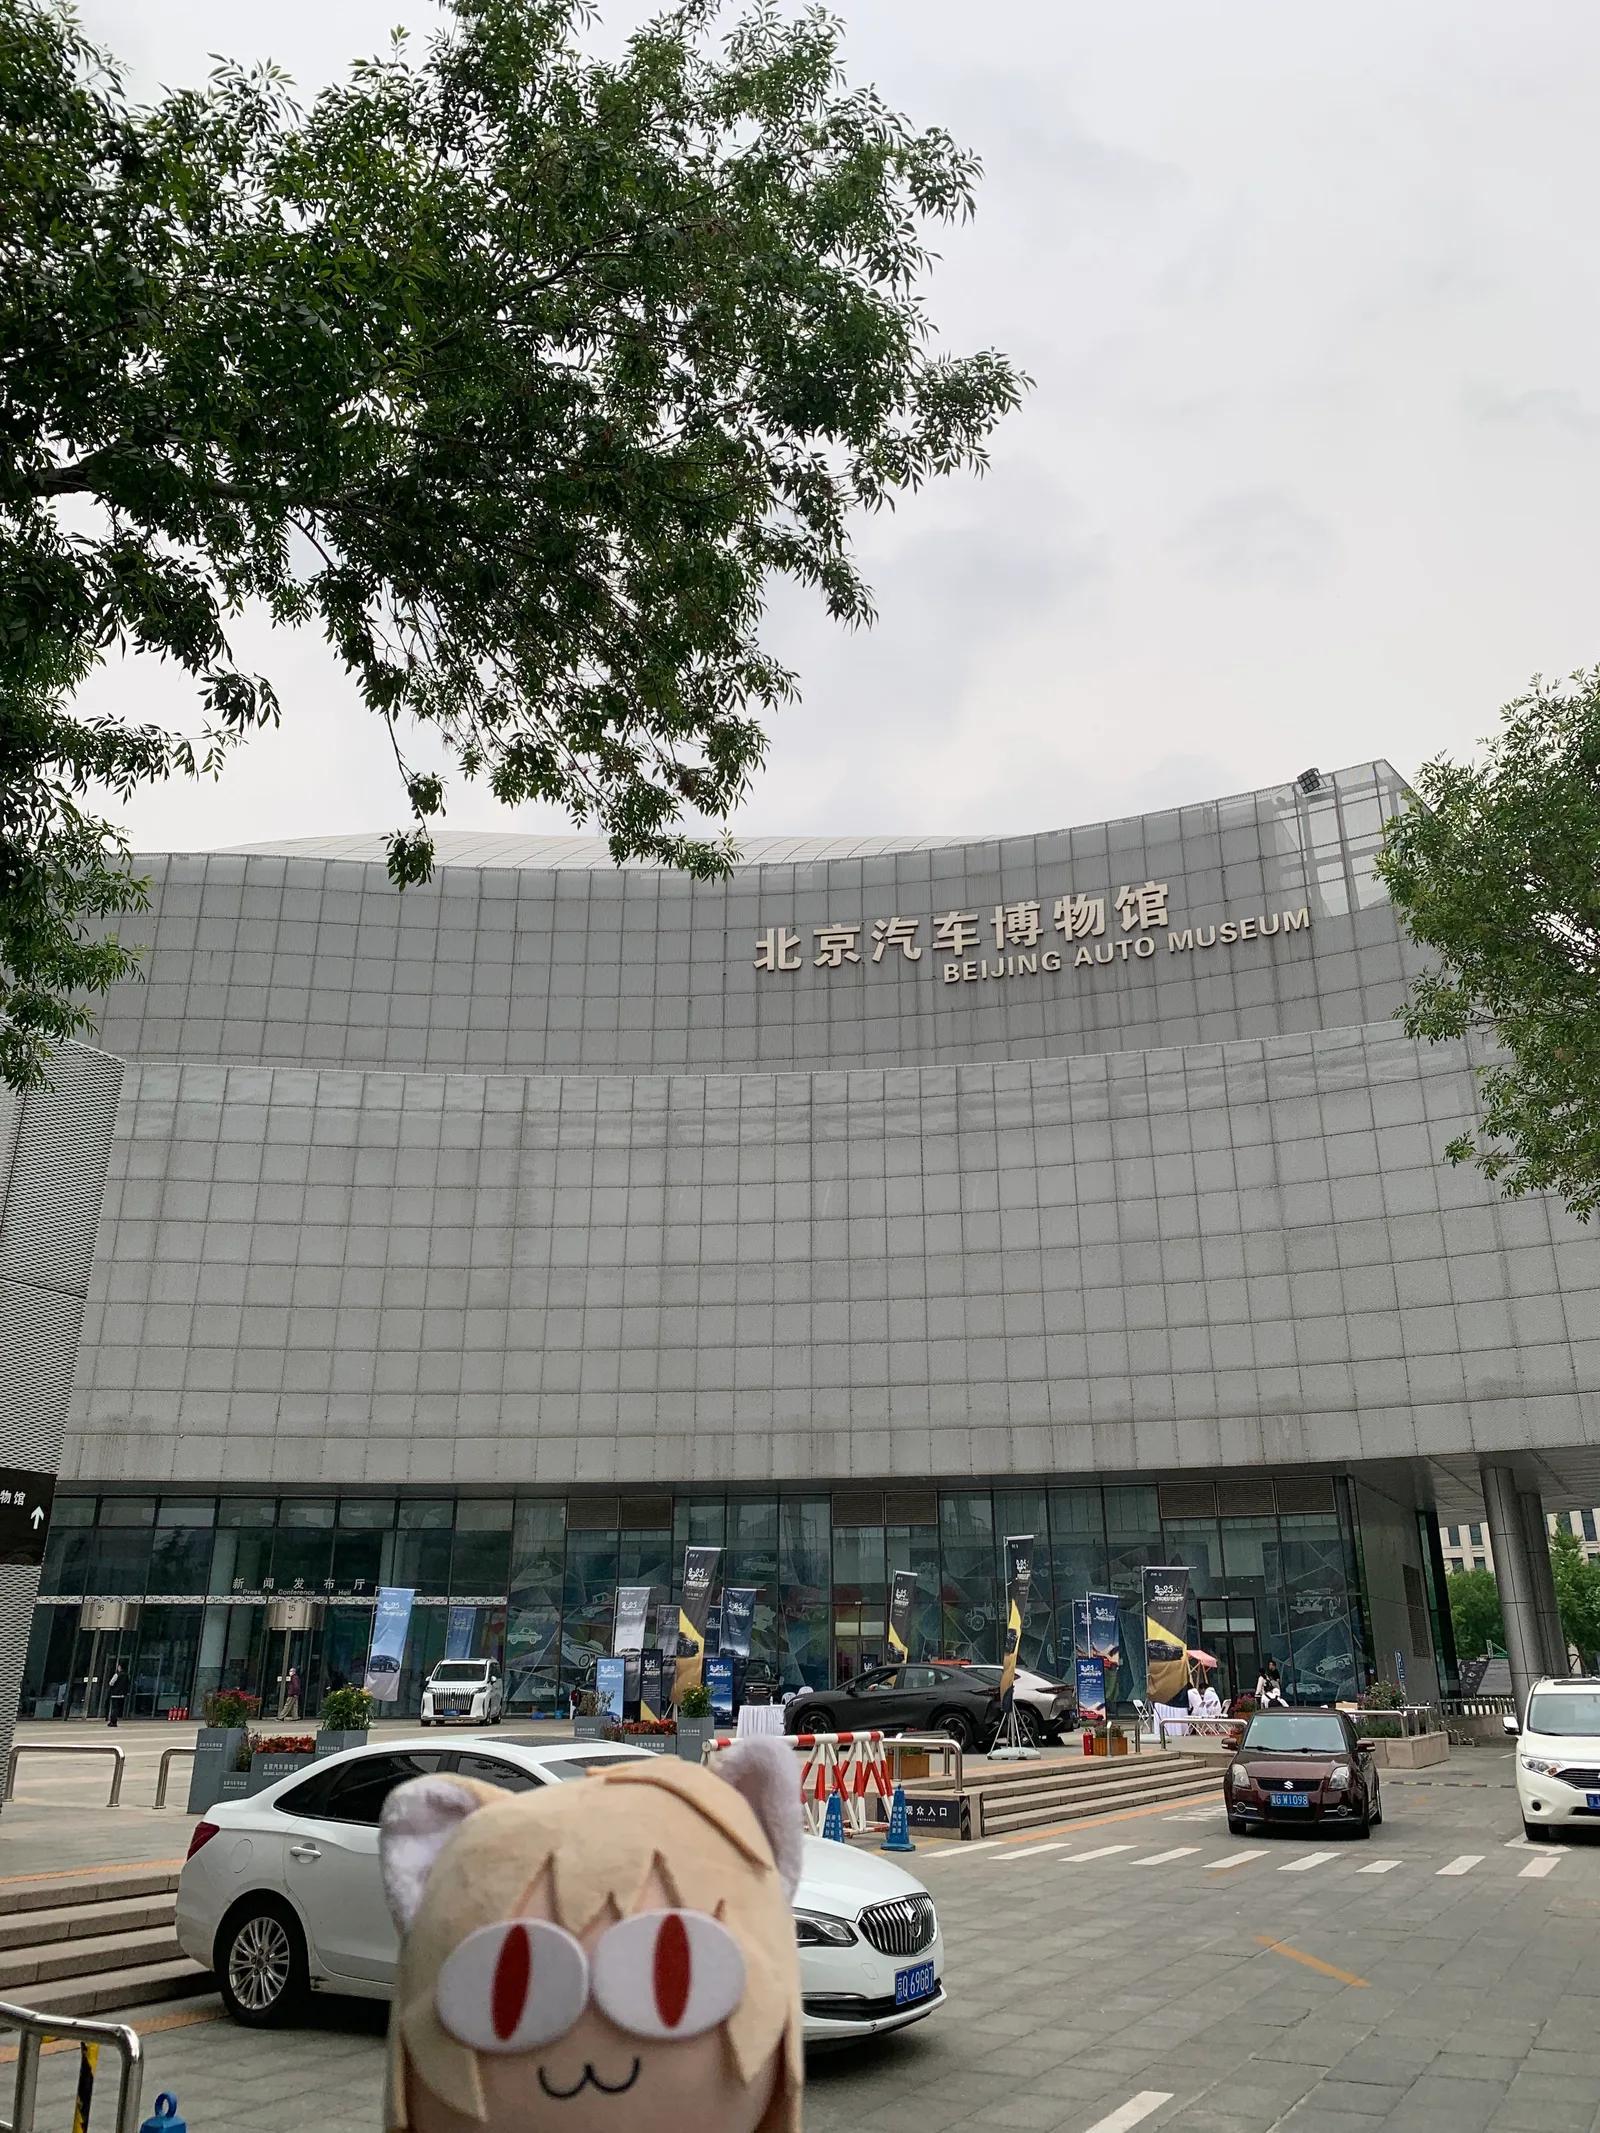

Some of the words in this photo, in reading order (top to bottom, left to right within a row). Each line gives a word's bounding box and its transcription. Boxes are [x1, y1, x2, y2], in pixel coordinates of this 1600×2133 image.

[754, 880, 1170, 971] 北京汽车博物馆
[943, 949, 1061, 984] BEIJING
[1073, 936, 1155, 967] AUTO
[1168, 907, 1310, 953] MUSEUM
[232, 1577, 366, 1591] 新闻发布厅
[288, 1604, 296, 1612] 15
[905, 1805, 948, 1817] 观众入口
